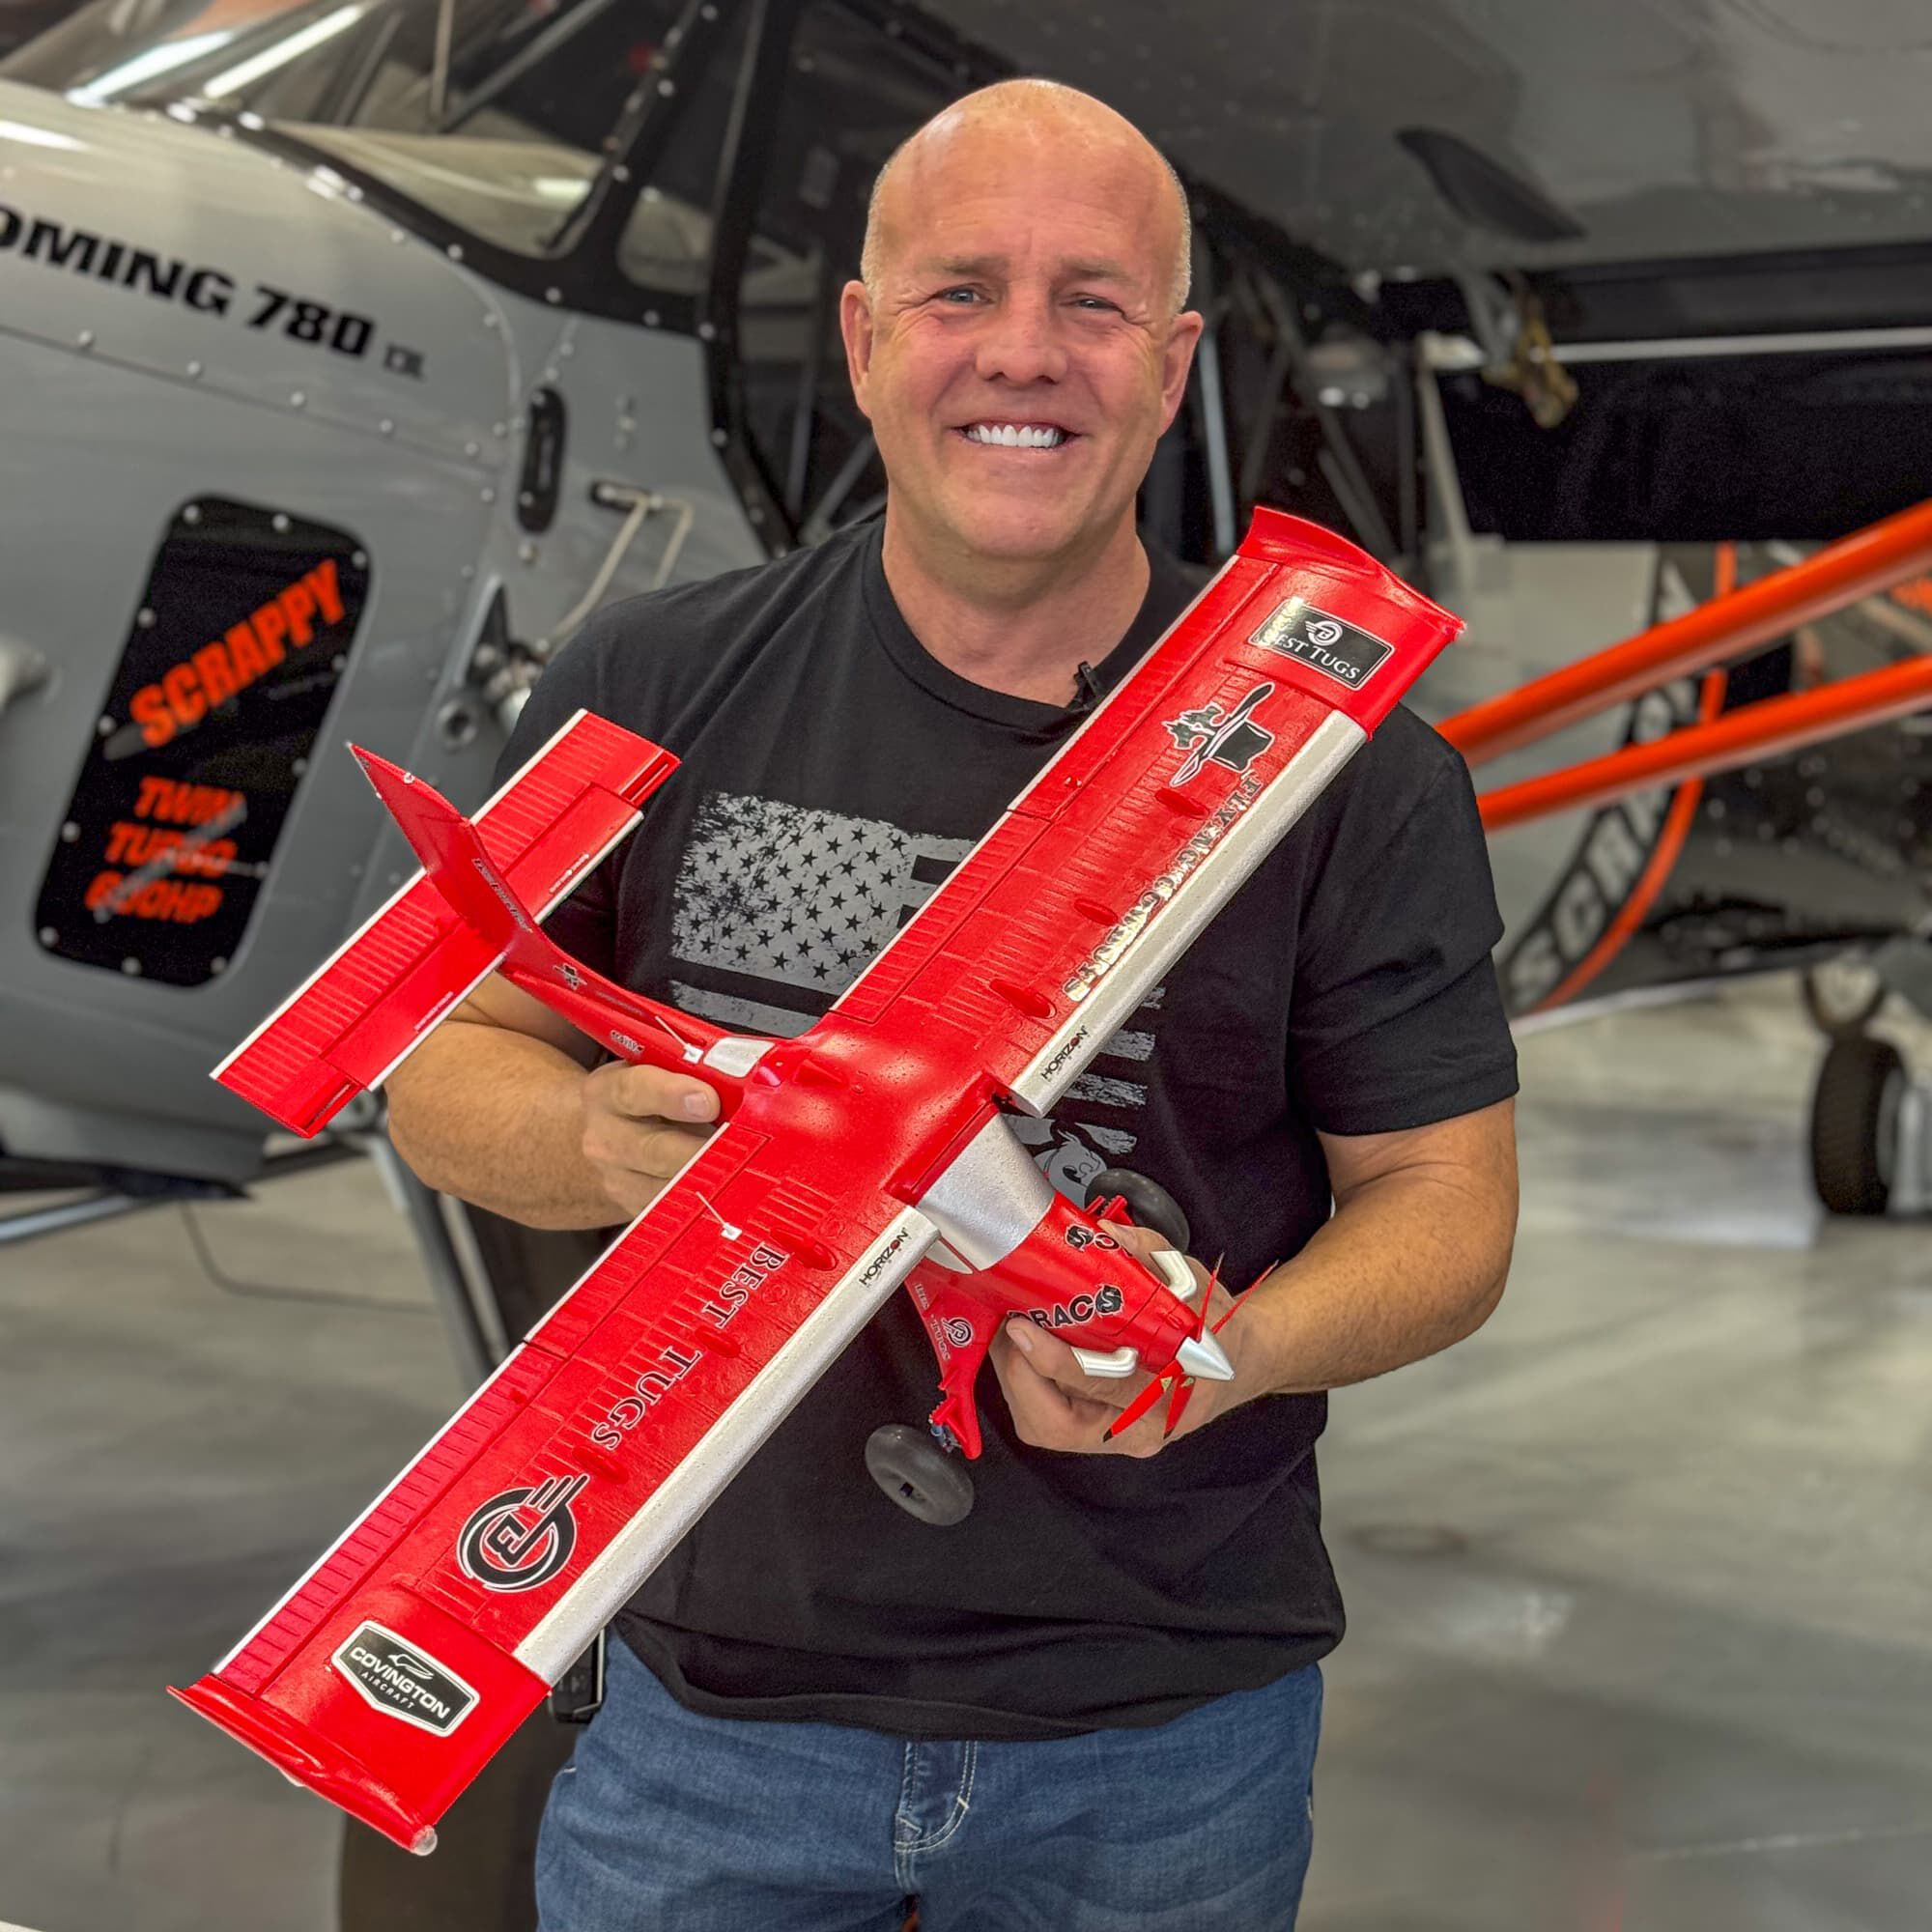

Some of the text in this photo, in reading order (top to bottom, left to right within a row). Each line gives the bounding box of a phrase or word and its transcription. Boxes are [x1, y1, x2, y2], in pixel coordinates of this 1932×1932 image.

[246, 285, 376, 358] 780
[129, 557, 344, 748] SCRAPPY
[1309, 645, 1361, 680] TUGS
[1040, 1027, 1089, 1080] HORIZON
[859, 1230, 909, 1286] HORIZON
[591, 1241, 790, 1451] BEST TUGS
[349, 1646, 451, 1719] COVINGTON
[360, 1671, 415, 1709] AIRCRAFT
